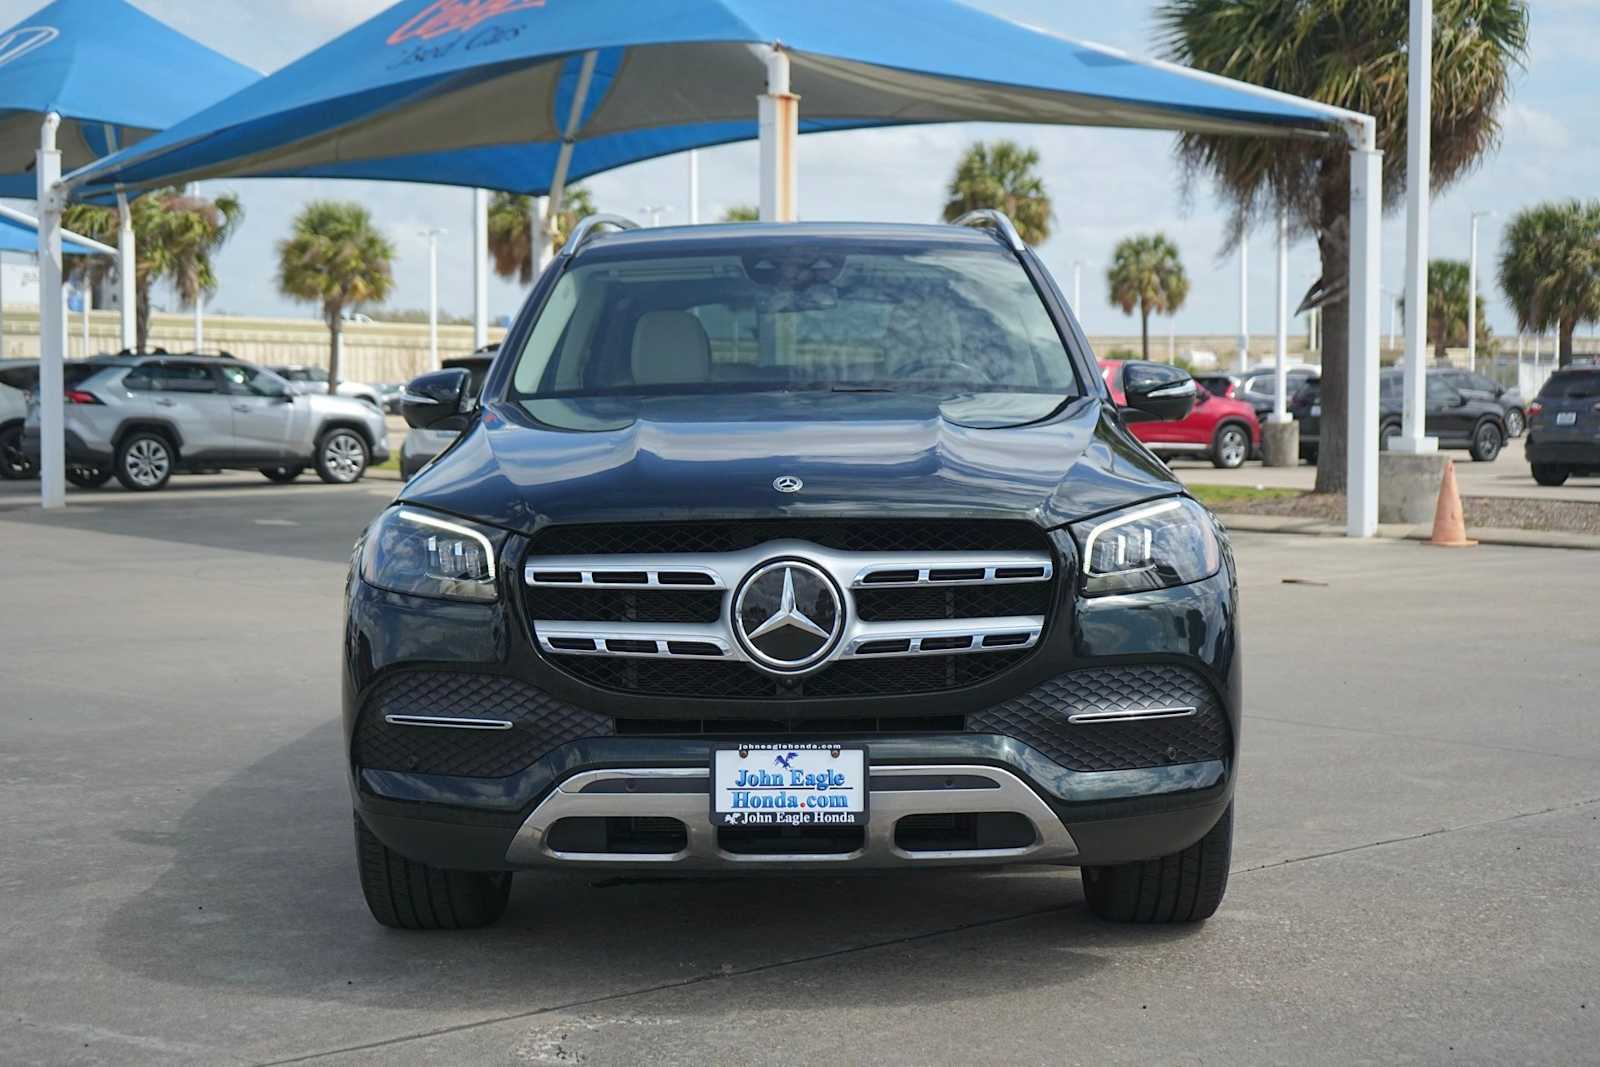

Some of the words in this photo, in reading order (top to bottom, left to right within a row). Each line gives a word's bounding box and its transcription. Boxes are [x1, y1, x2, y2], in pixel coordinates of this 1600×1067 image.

[735, 769, 784, 787] John
[790, 768, 845, 790] Eagle
[731, 791, 848, 808] Honda.com
[741, 812, 772, 824] John
[776, 812, 810, 825] Eagle
[813, 812, 855, 823] Honda
